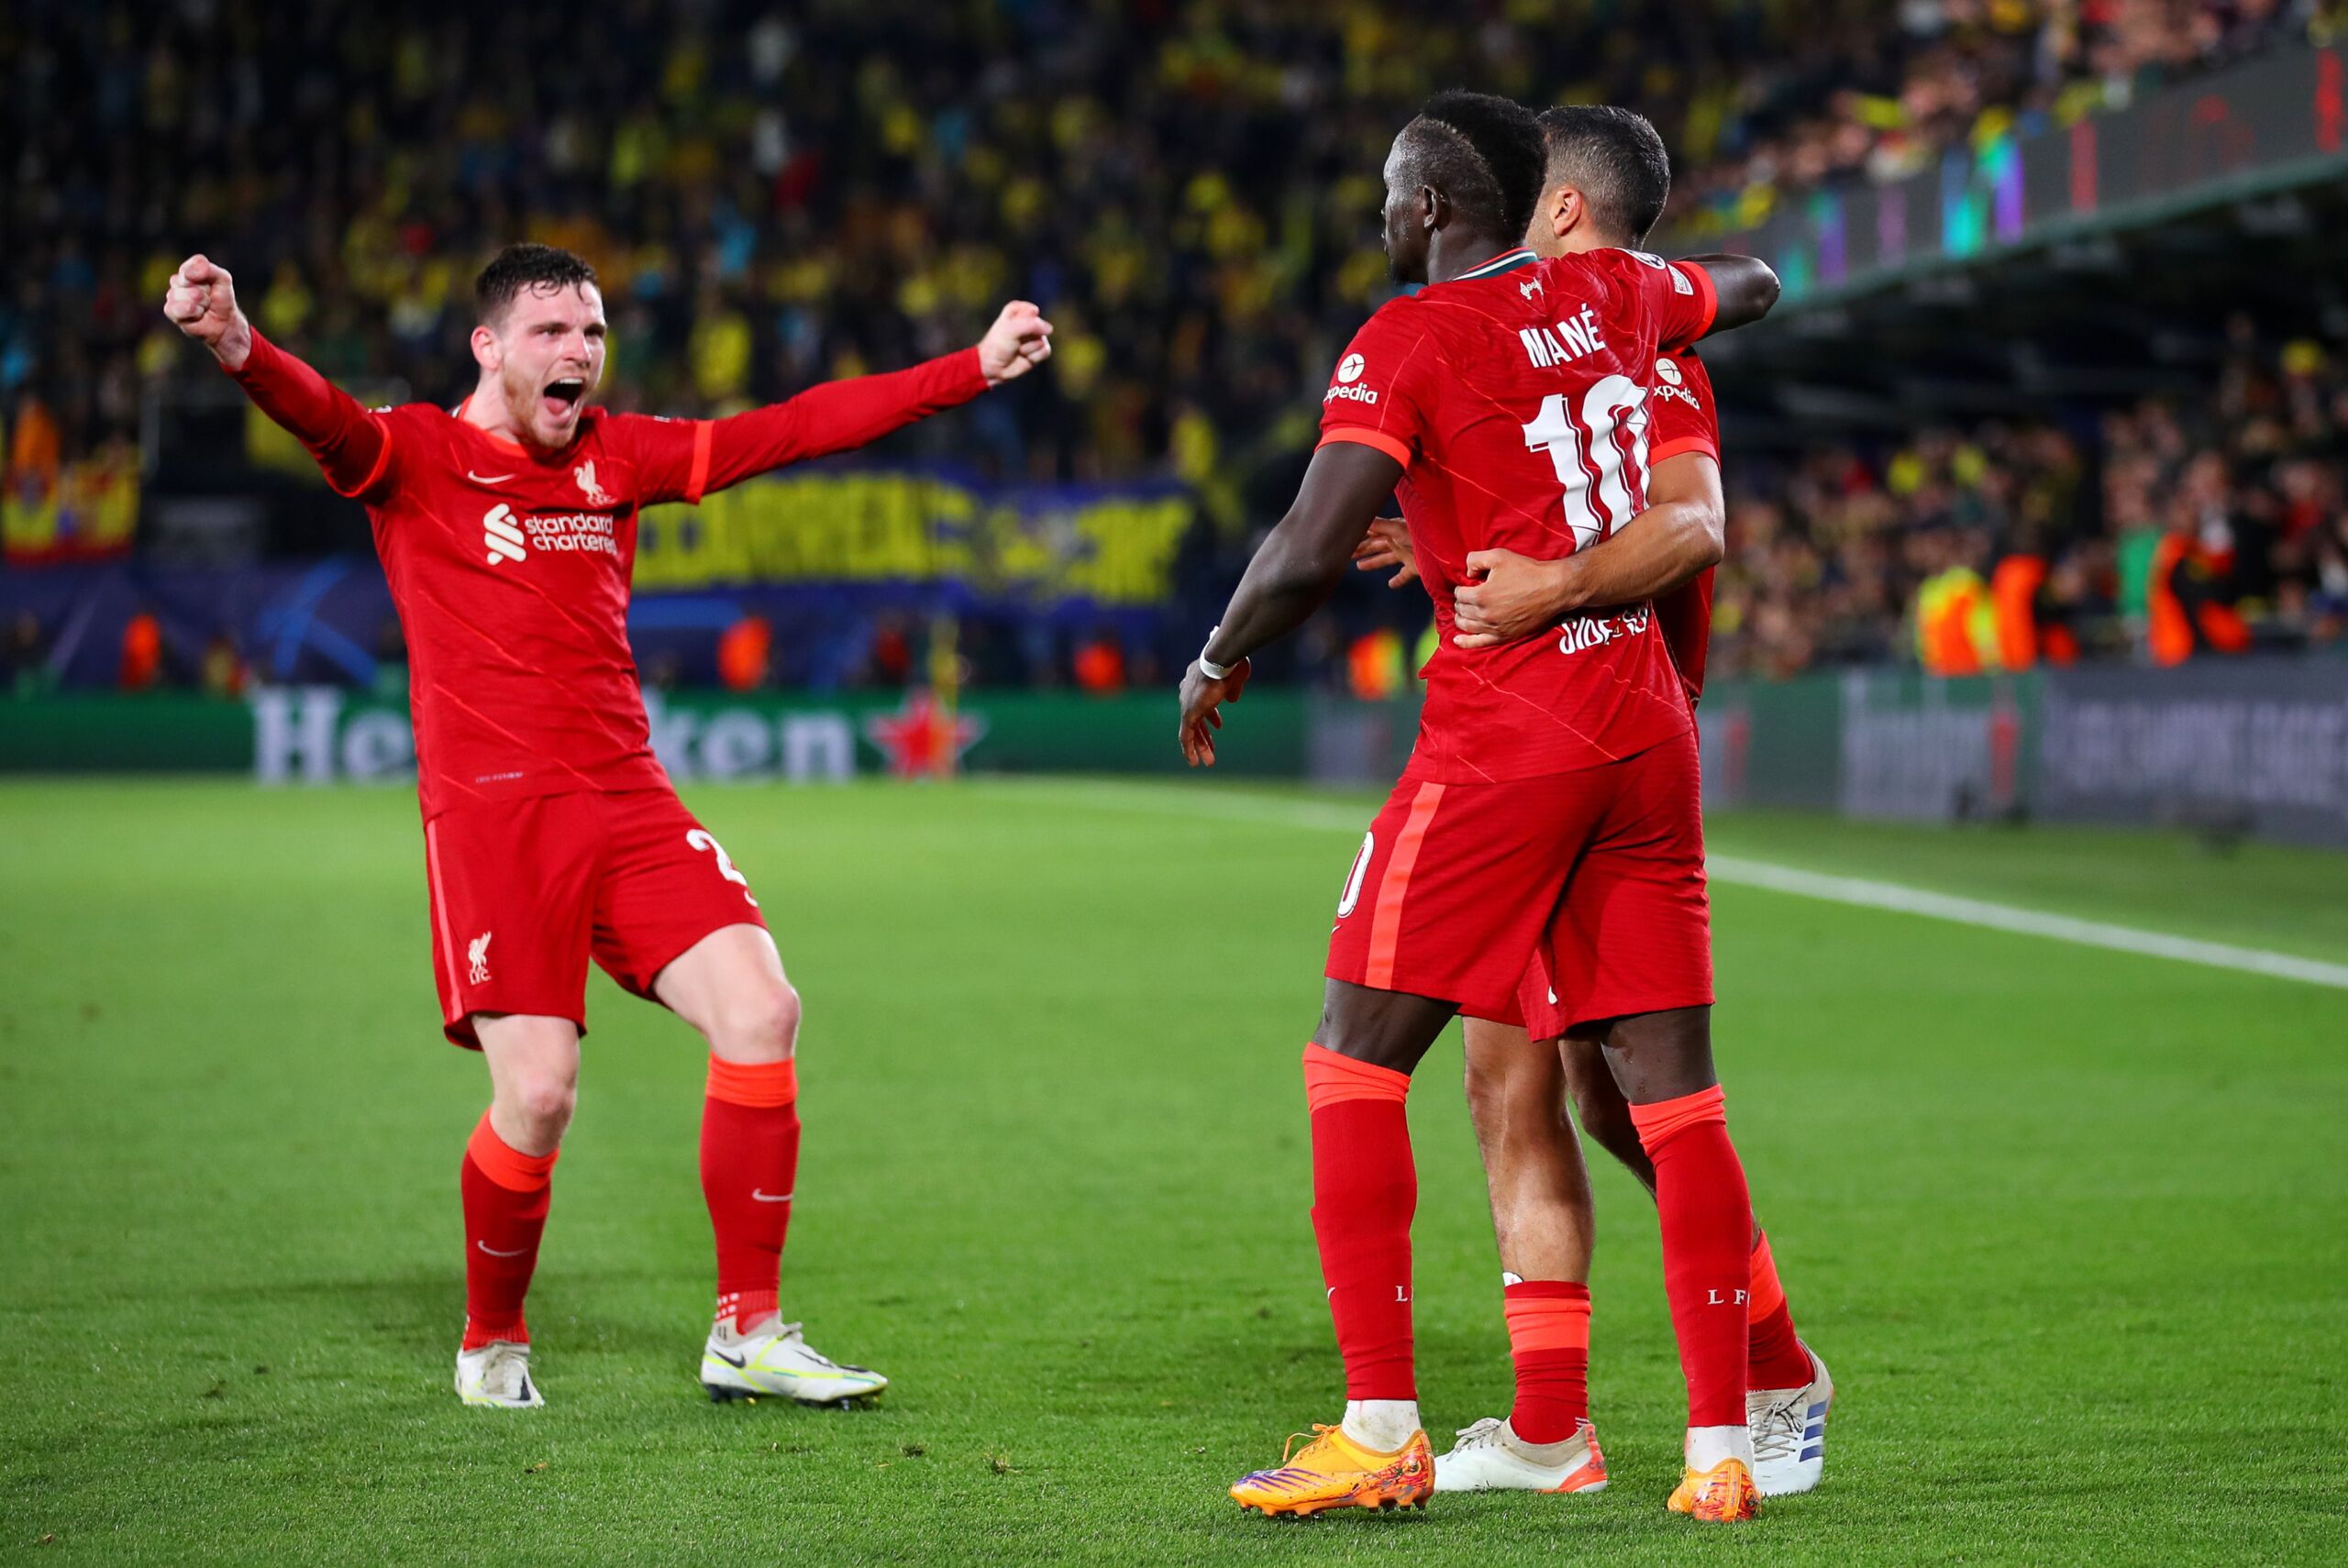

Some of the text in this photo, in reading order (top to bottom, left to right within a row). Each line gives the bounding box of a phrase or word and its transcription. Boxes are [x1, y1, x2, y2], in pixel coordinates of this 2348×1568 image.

[1519, 303, 1606, 369] MANÉ
[1323, 381, 1379, 405] xpedia
[1653, 384, 1700, 411] xpedia
[1521, 374, 1651, 553] 10
[524, 513, 615, 536] standard
[252, 686, 854, 786] Heken
